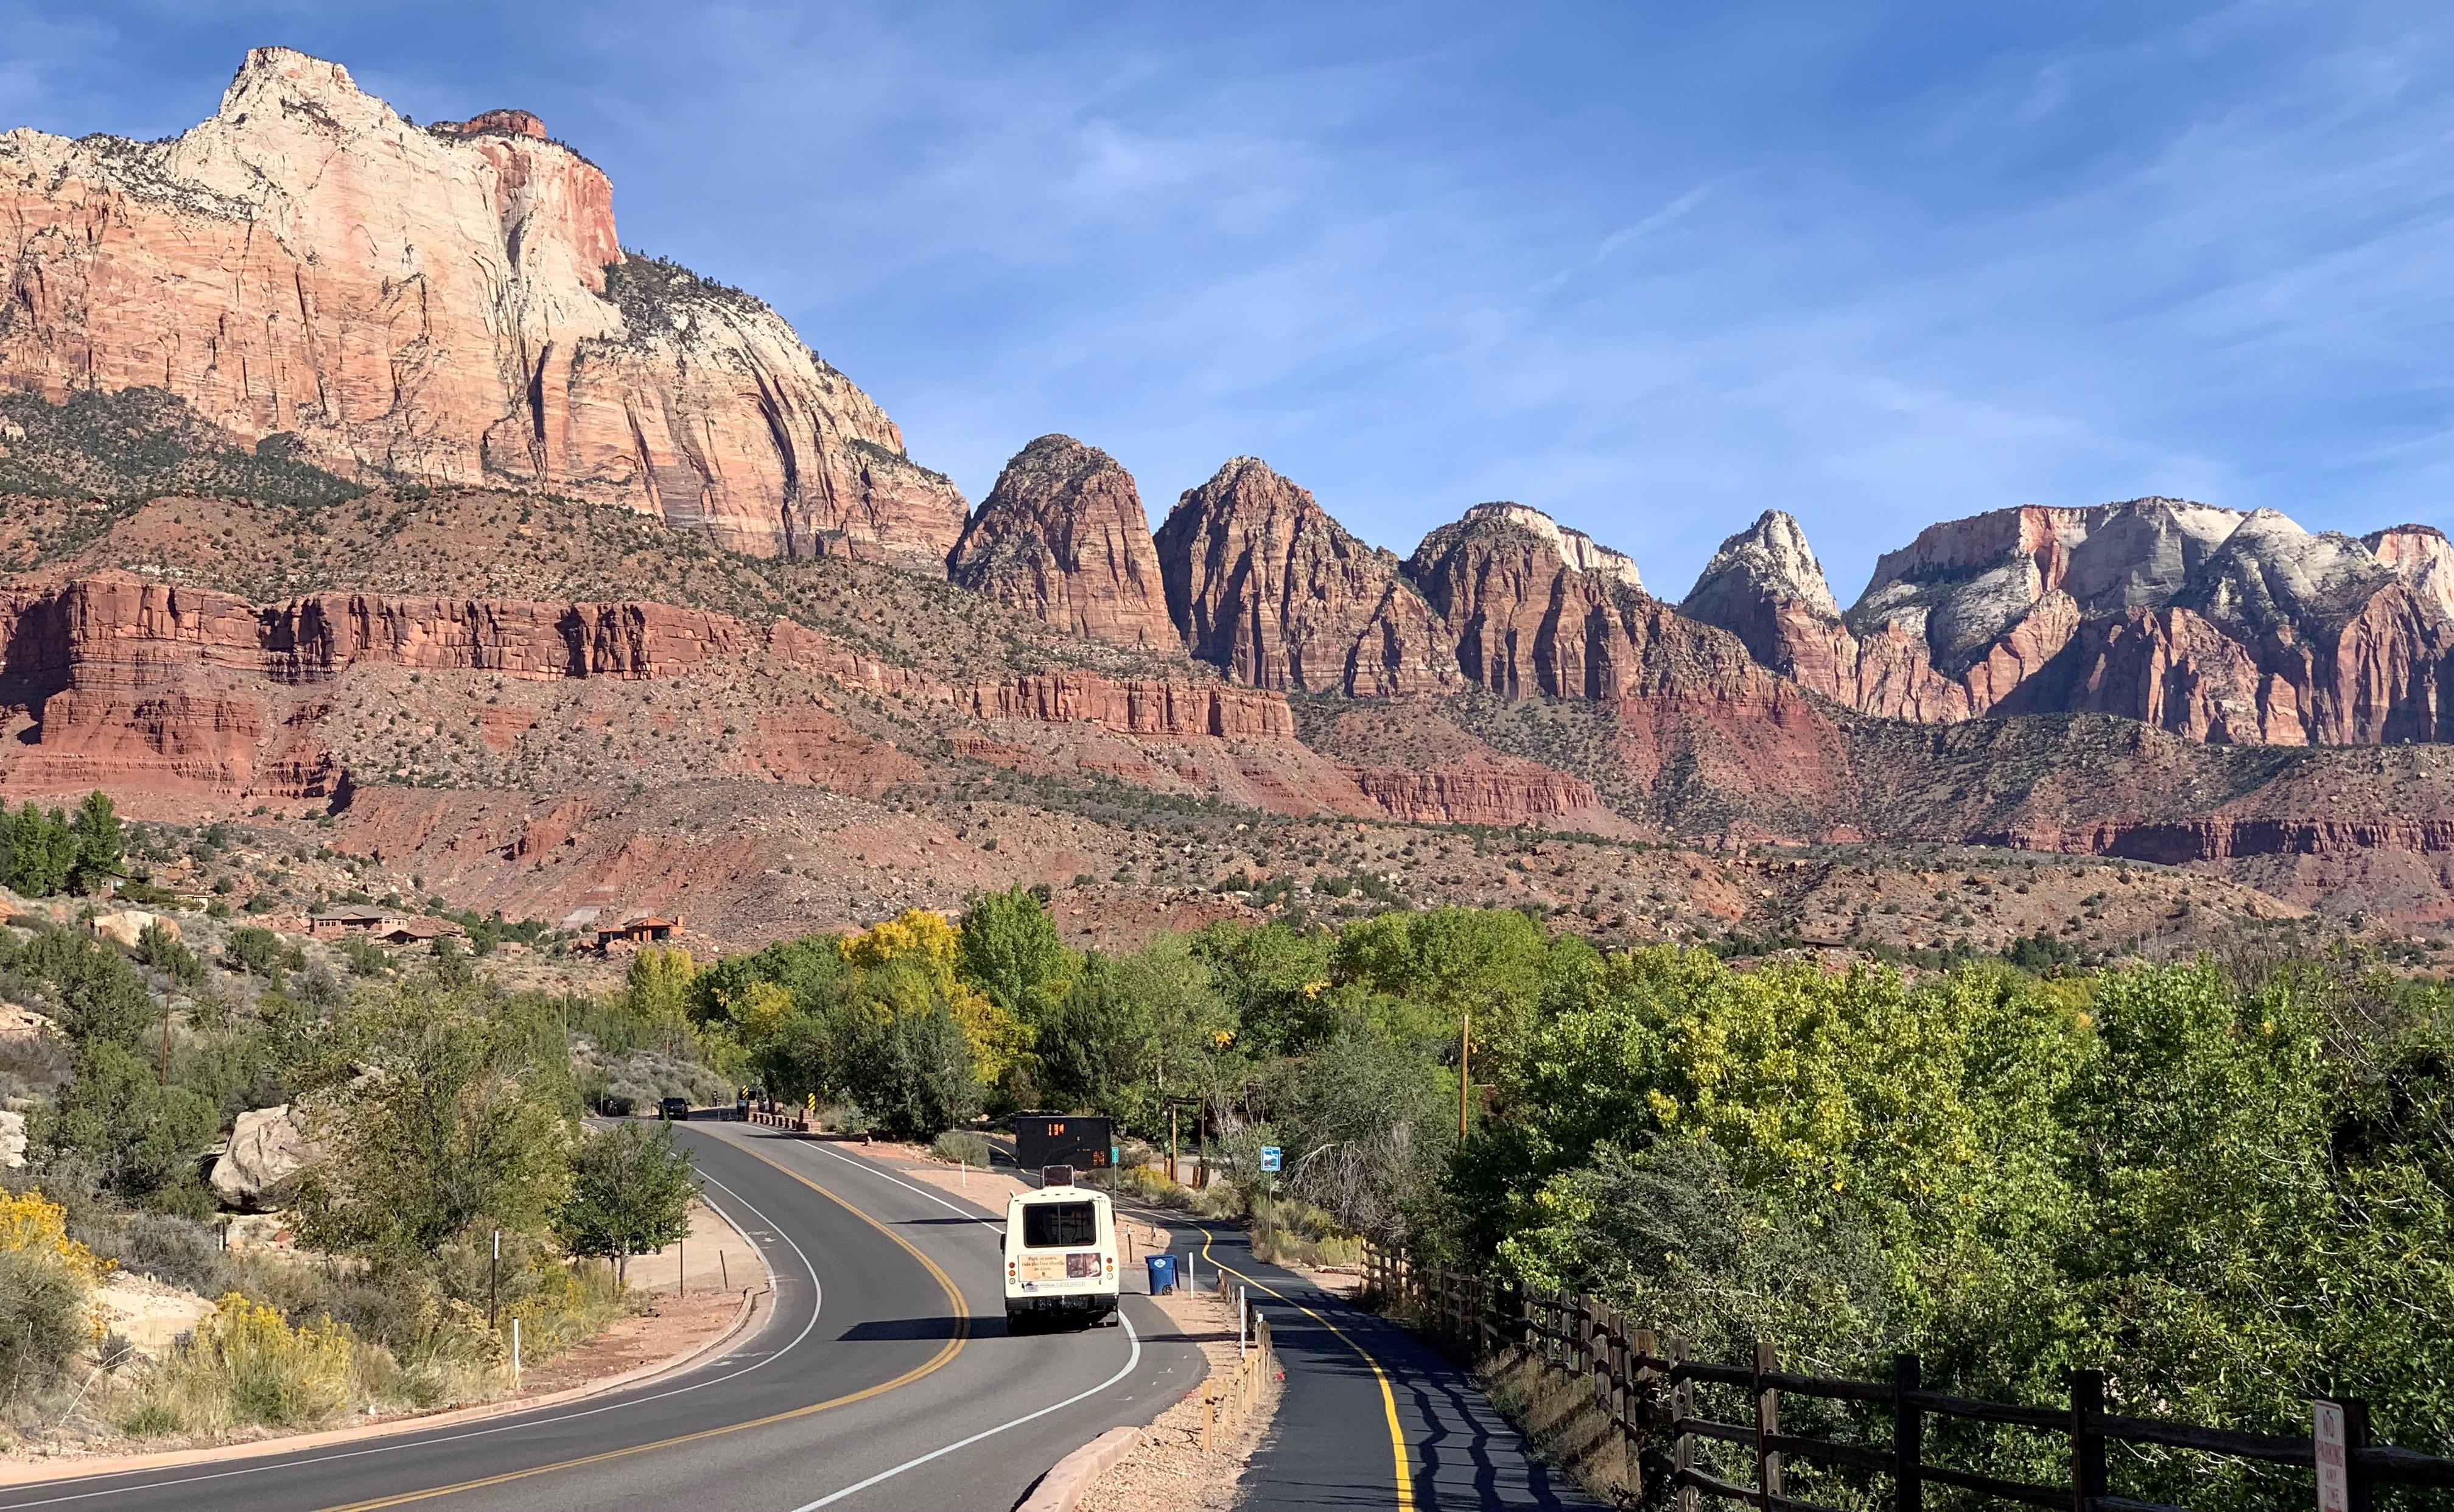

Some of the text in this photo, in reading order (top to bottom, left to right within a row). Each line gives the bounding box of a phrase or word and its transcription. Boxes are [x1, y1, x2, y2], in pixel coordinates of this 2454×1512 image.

[2323, 1414, 2334, 1438] NO
[2318, 1440, 2343, 1468] PARKING
[2326, 1469, 2337, 1483] ANY
[2325, 1485, 2339, 1503] TIME
